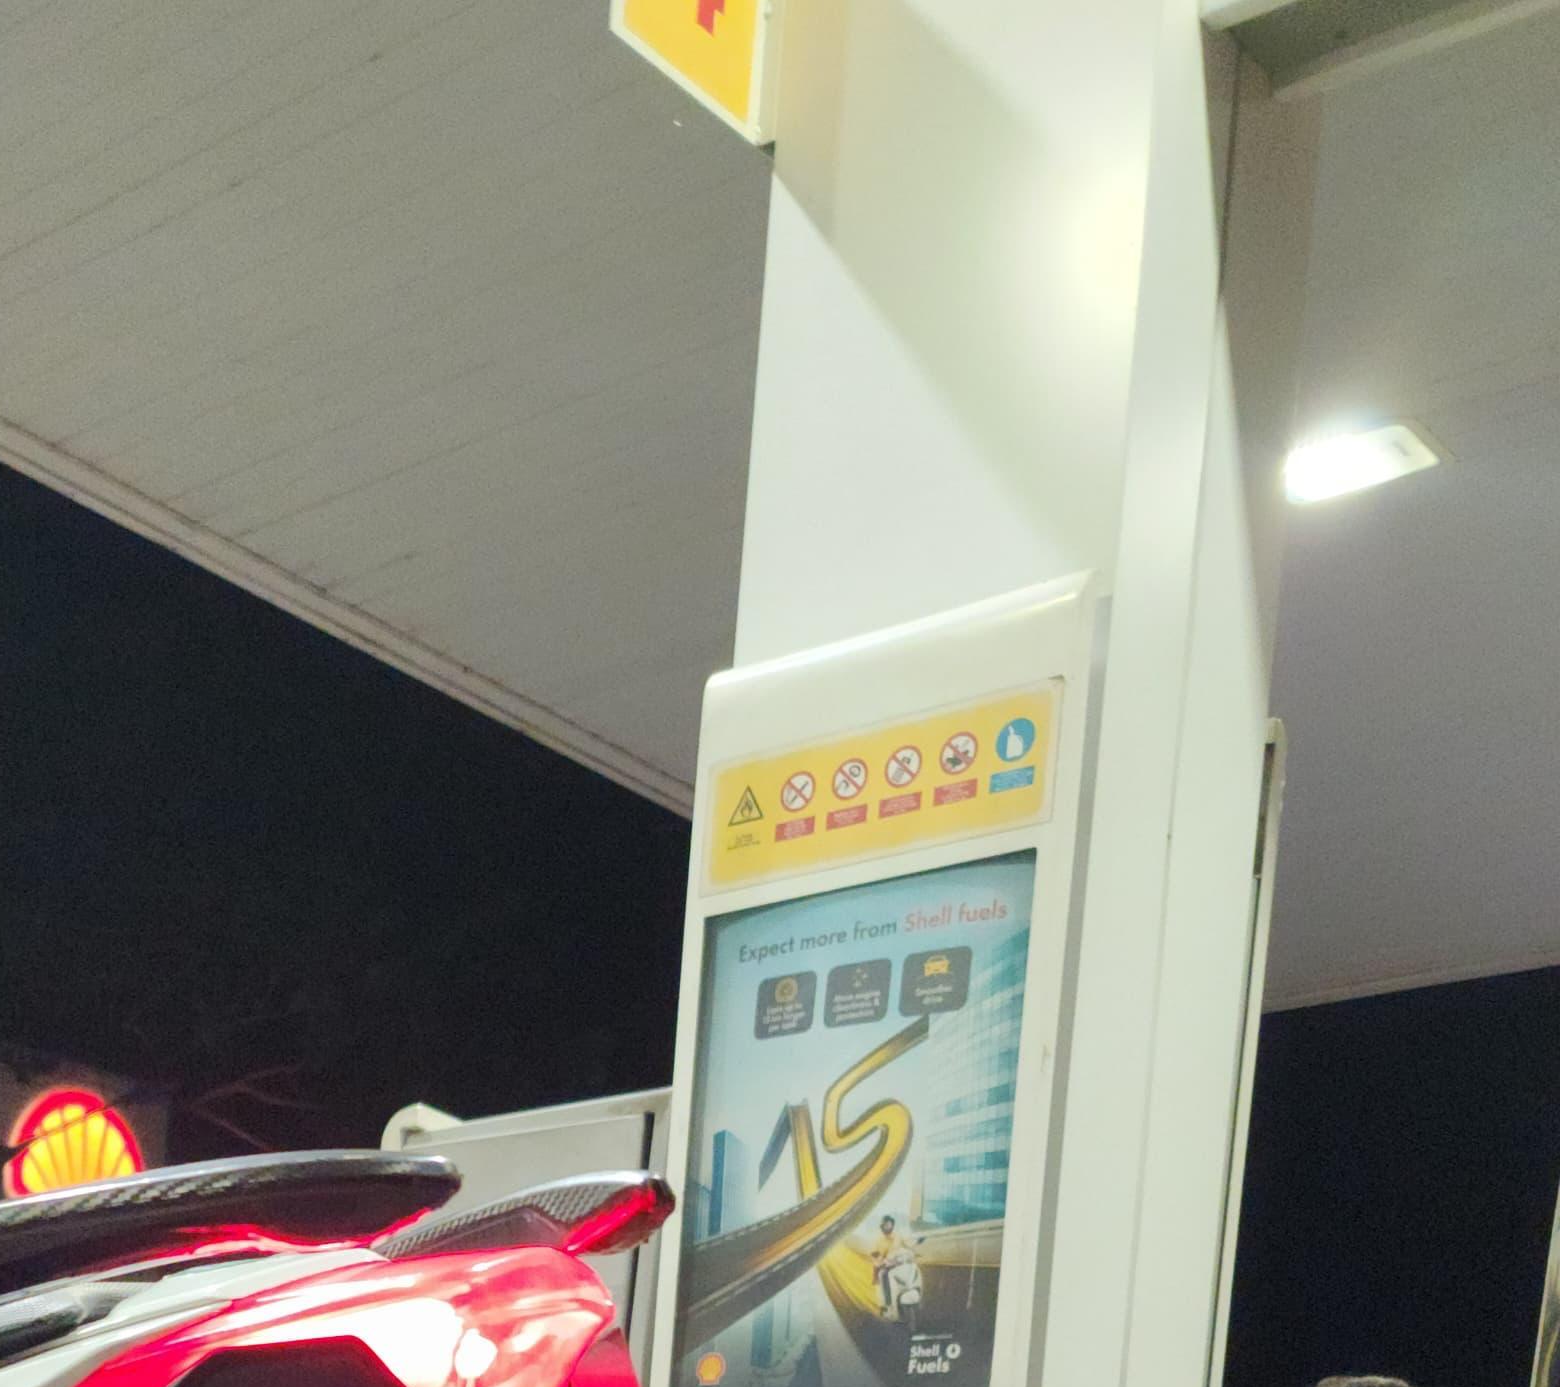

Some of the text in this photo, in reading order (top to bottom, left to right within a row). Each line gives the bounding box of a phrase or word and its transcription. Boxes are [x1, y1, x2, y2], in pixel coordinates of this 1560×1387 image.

[737, 898, 1007, 964] Expect more from Shell fuels
[909, 1342, 941, 1358] Shell
[907, 1356, 951, 1375] Fuels
